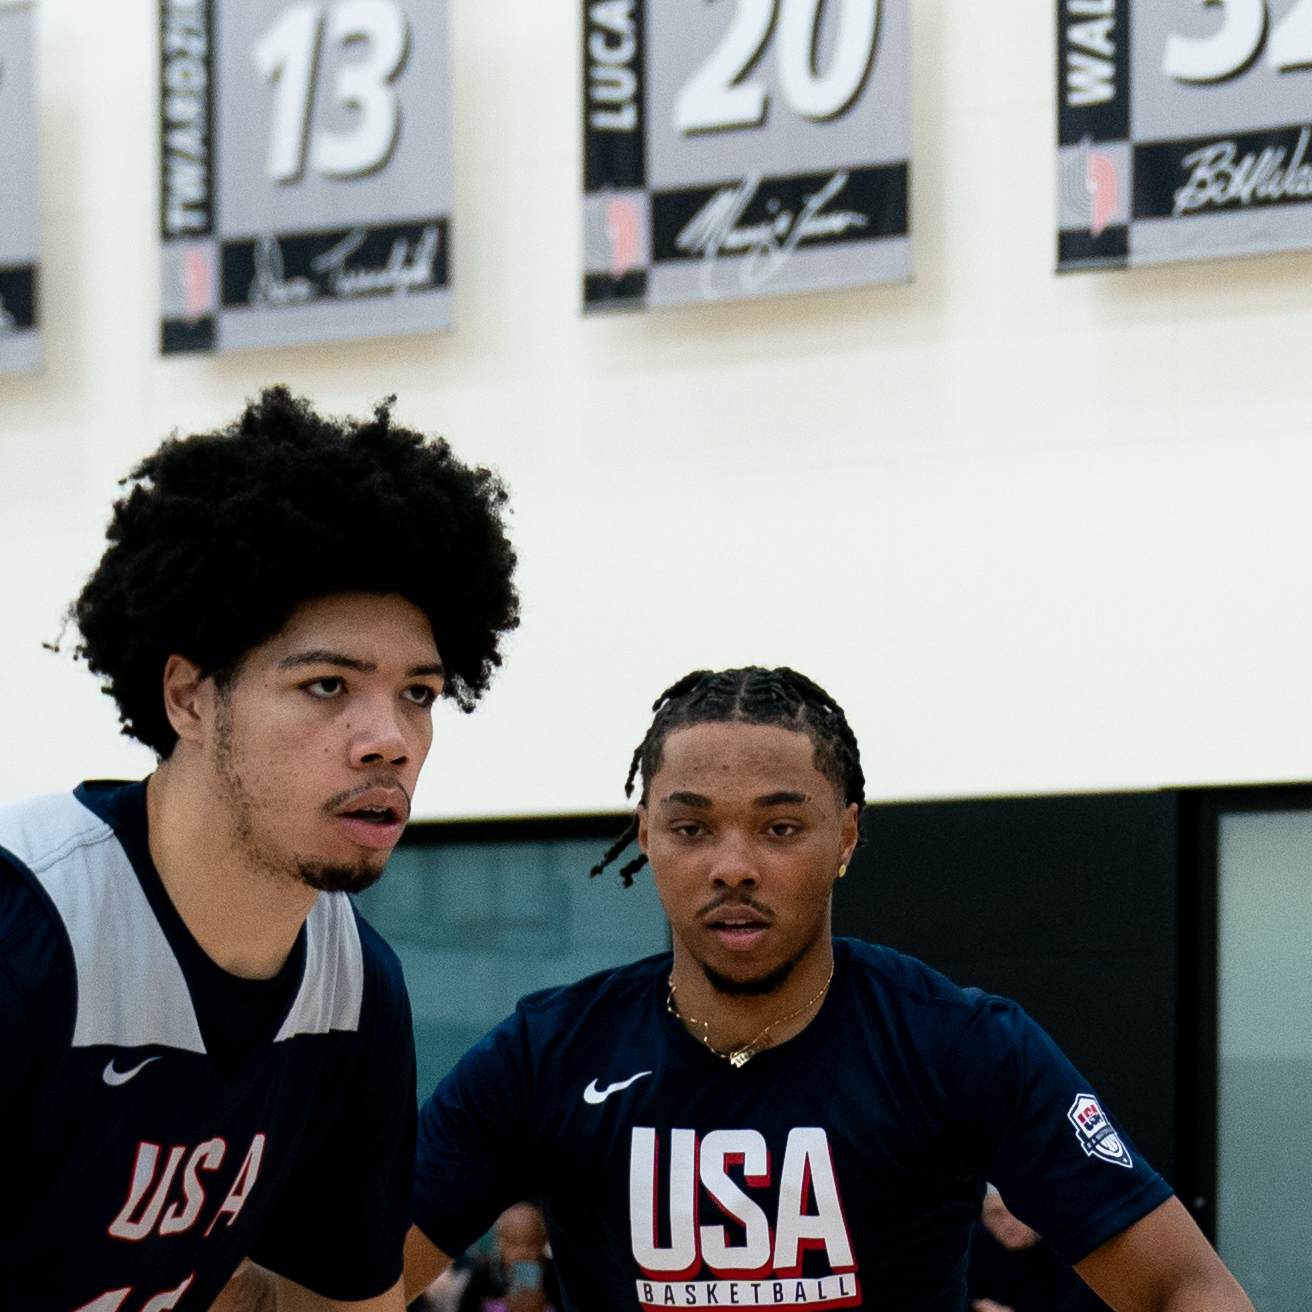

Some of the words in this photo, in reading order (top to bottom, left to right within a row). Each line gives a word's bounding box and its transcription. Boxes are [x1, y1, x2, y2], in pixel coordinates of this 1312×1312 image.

[252, 0, 408, 183] 13
[108, 1133, 266, 1241] USA
[630, 1126, 857, 1279] USA
[643, 1276, 850, 1306] BASKETBALL
